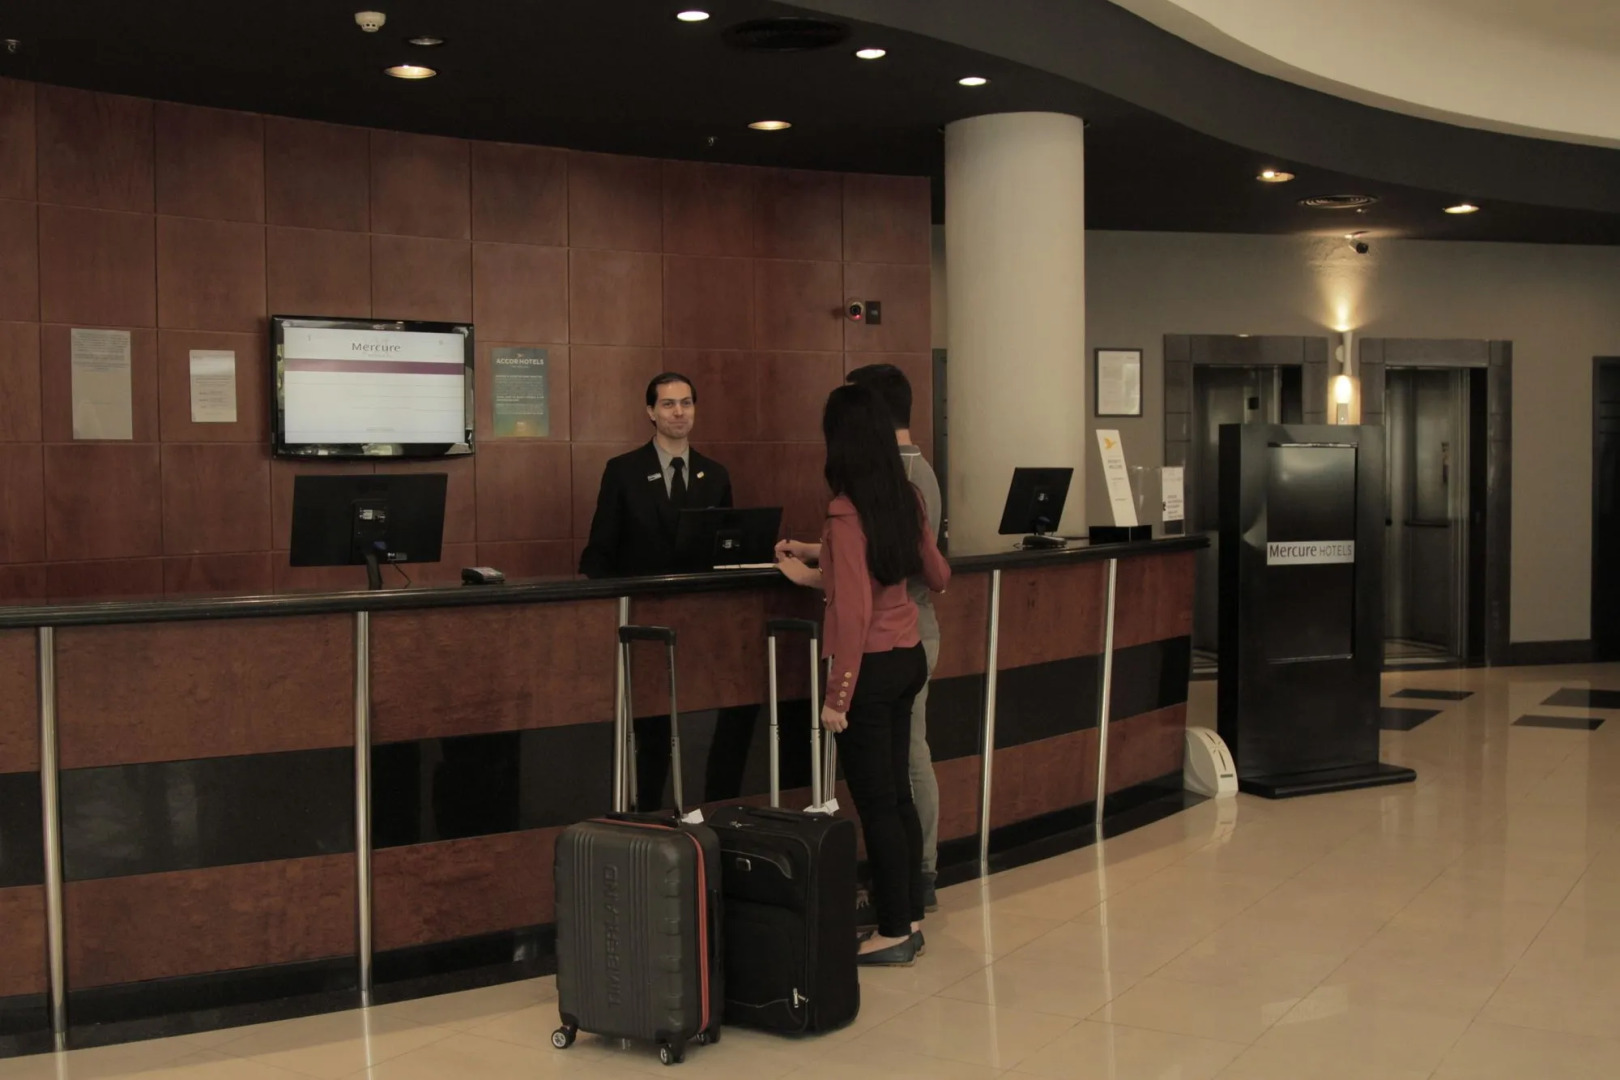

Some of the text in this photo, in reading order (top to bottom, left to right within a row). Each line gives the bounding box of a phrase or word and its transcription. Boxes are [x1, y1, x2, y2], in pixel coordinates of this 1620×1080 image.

[351, 342, 401, 352] Mercure
[1269, 544, 1352, 558] Mercure HOTELS
[603, 864, 620, 1008] TIMBERLAND
